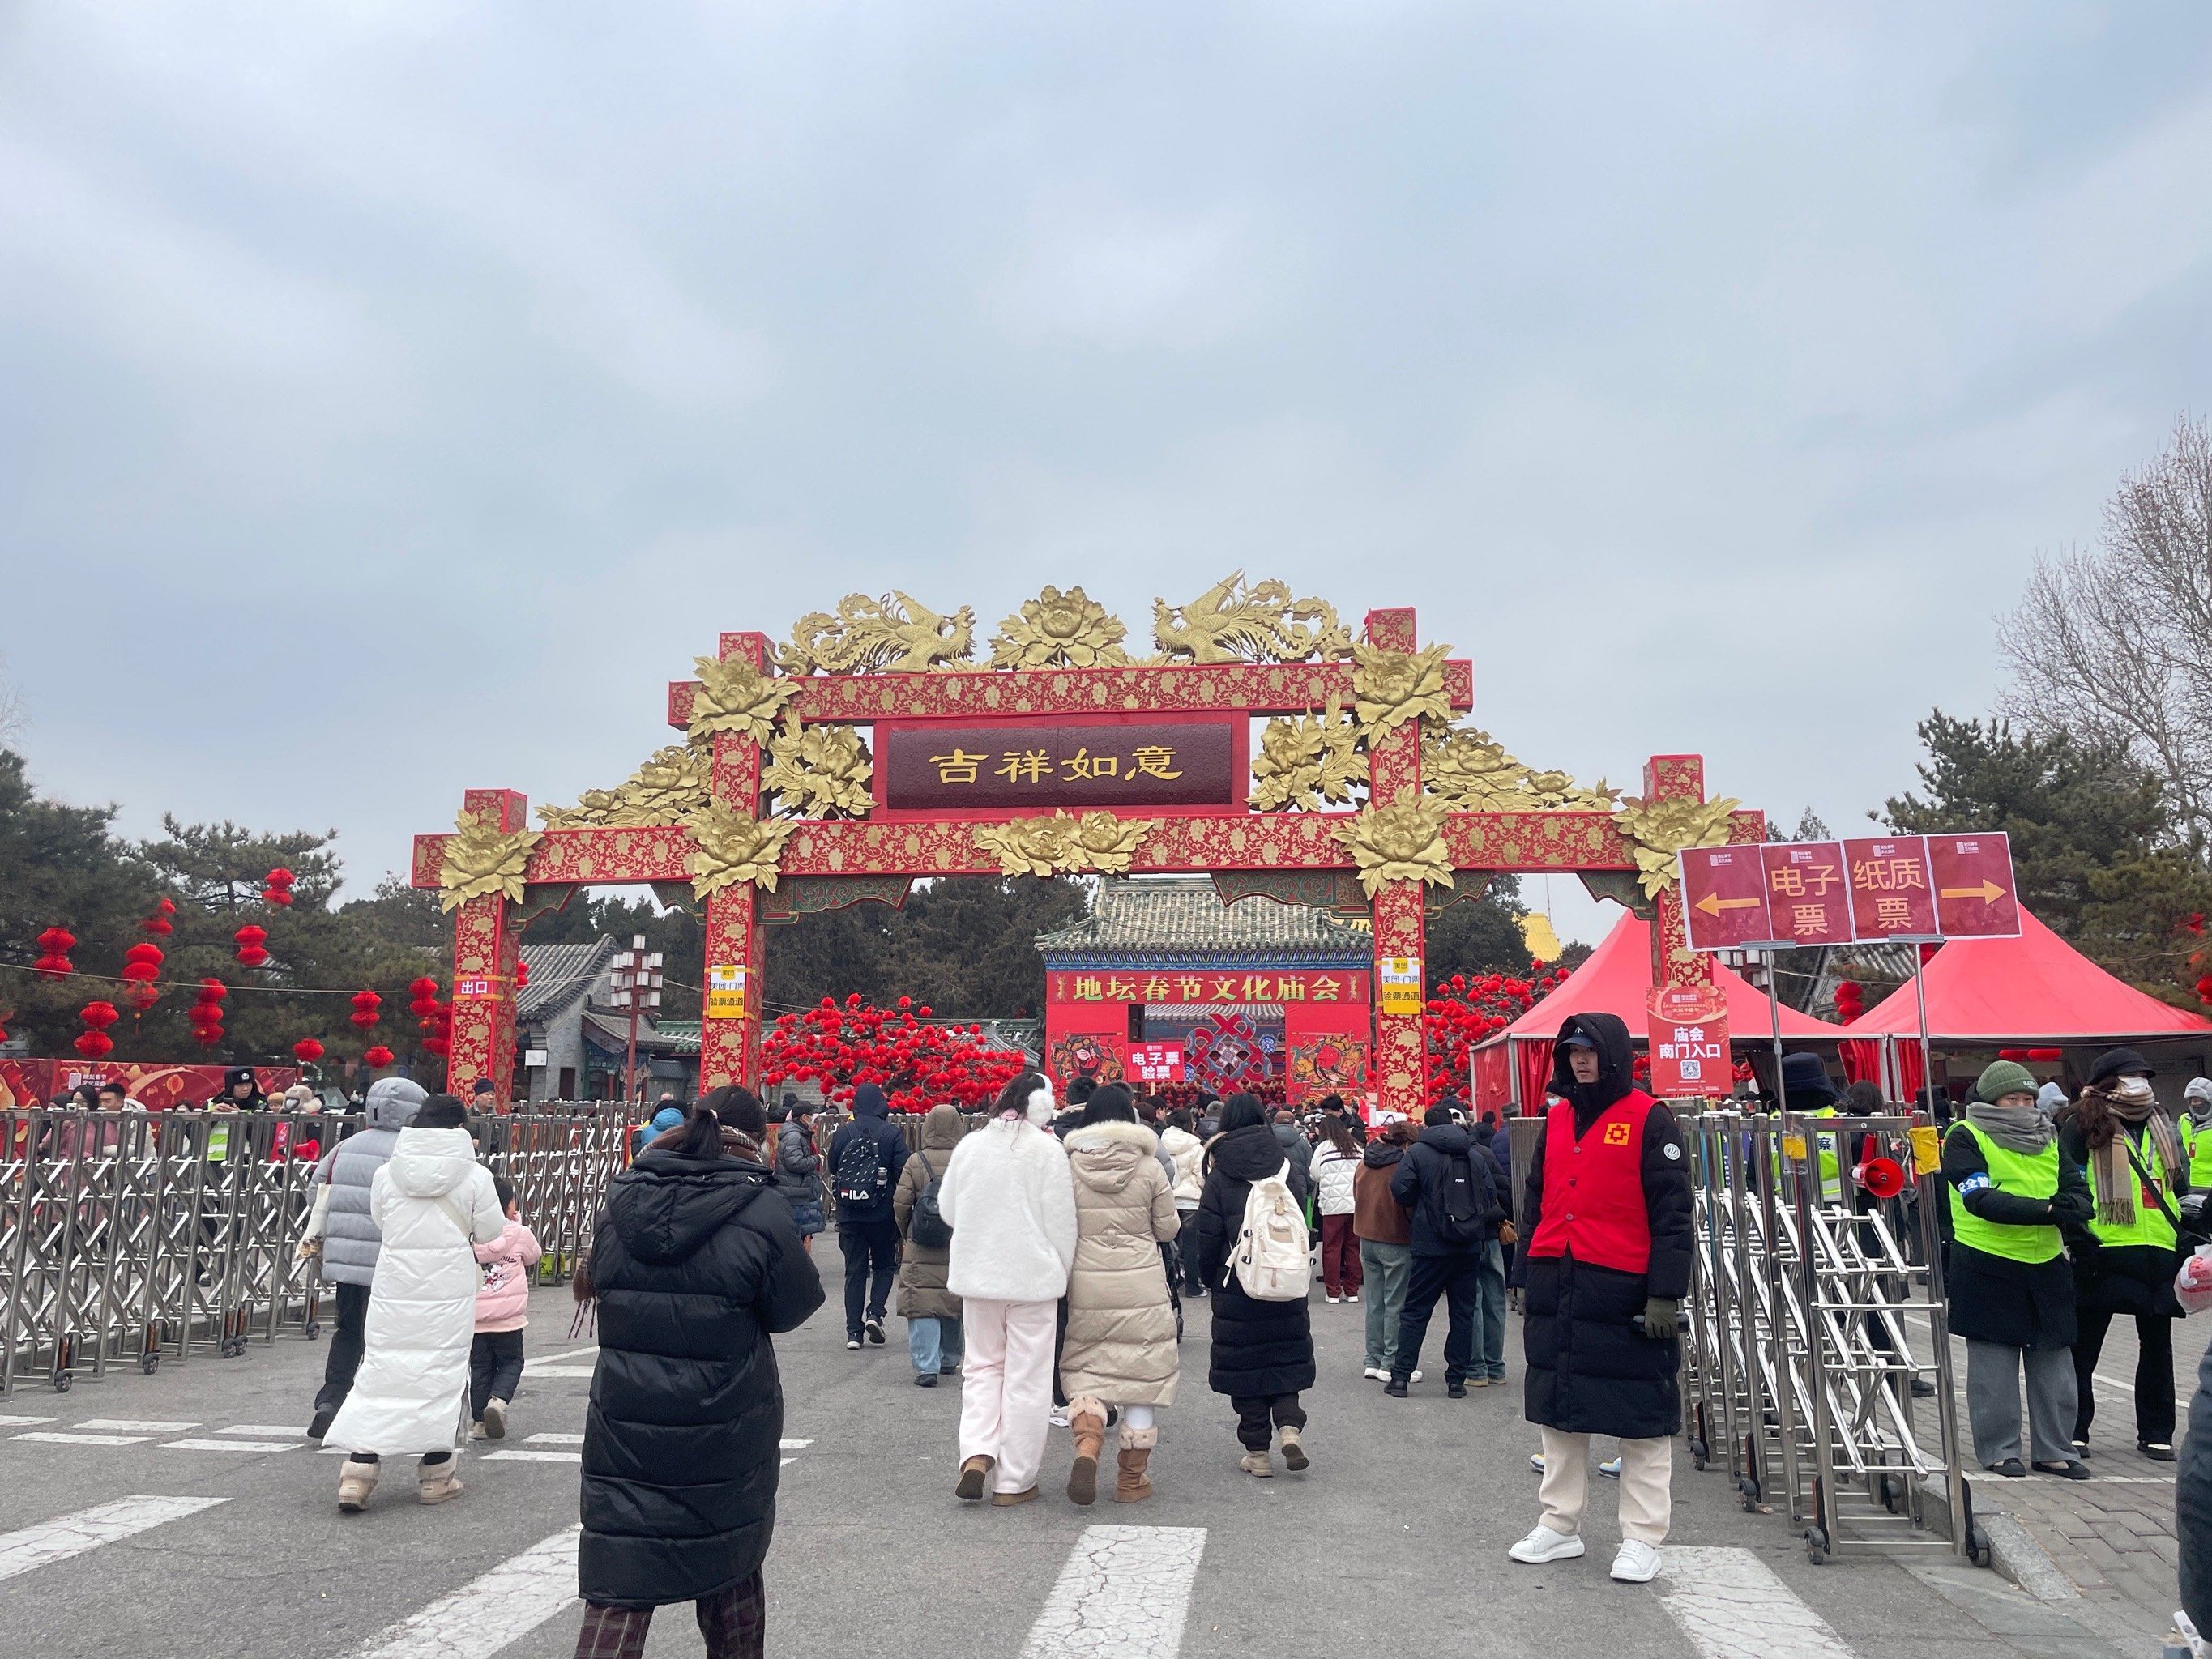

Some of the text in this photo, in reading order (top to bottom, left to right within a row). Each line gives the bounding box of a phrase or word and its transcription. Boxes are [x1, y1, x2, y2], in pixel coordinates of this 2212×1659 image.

[929, 744, 1184, 783] 吉祥如意
[1770, 864, 1840, 897] 电子
[1853, 857, 1924, 891] 纸质
[1791, 903, 1829, 936] 票
[1875, 897, 1912, 929] 票
[461, 980, 488, 994] 出口
[1073, 975, 1342, 1001] 地坛春节文化庙会
[710, 997, 743, 1005] 验票通道
[1383, 992, 1420, 1000] 验票通道
[1674, 1026, 1704, 1042] 庙会
[1132, 1051, 1180, 1065] 电子票
[1659, 1043, 1721, 1059] 南门入口
[1142, 1065, 1171, 1079] 验票
[840, 1188, 869, 1200] FILA
